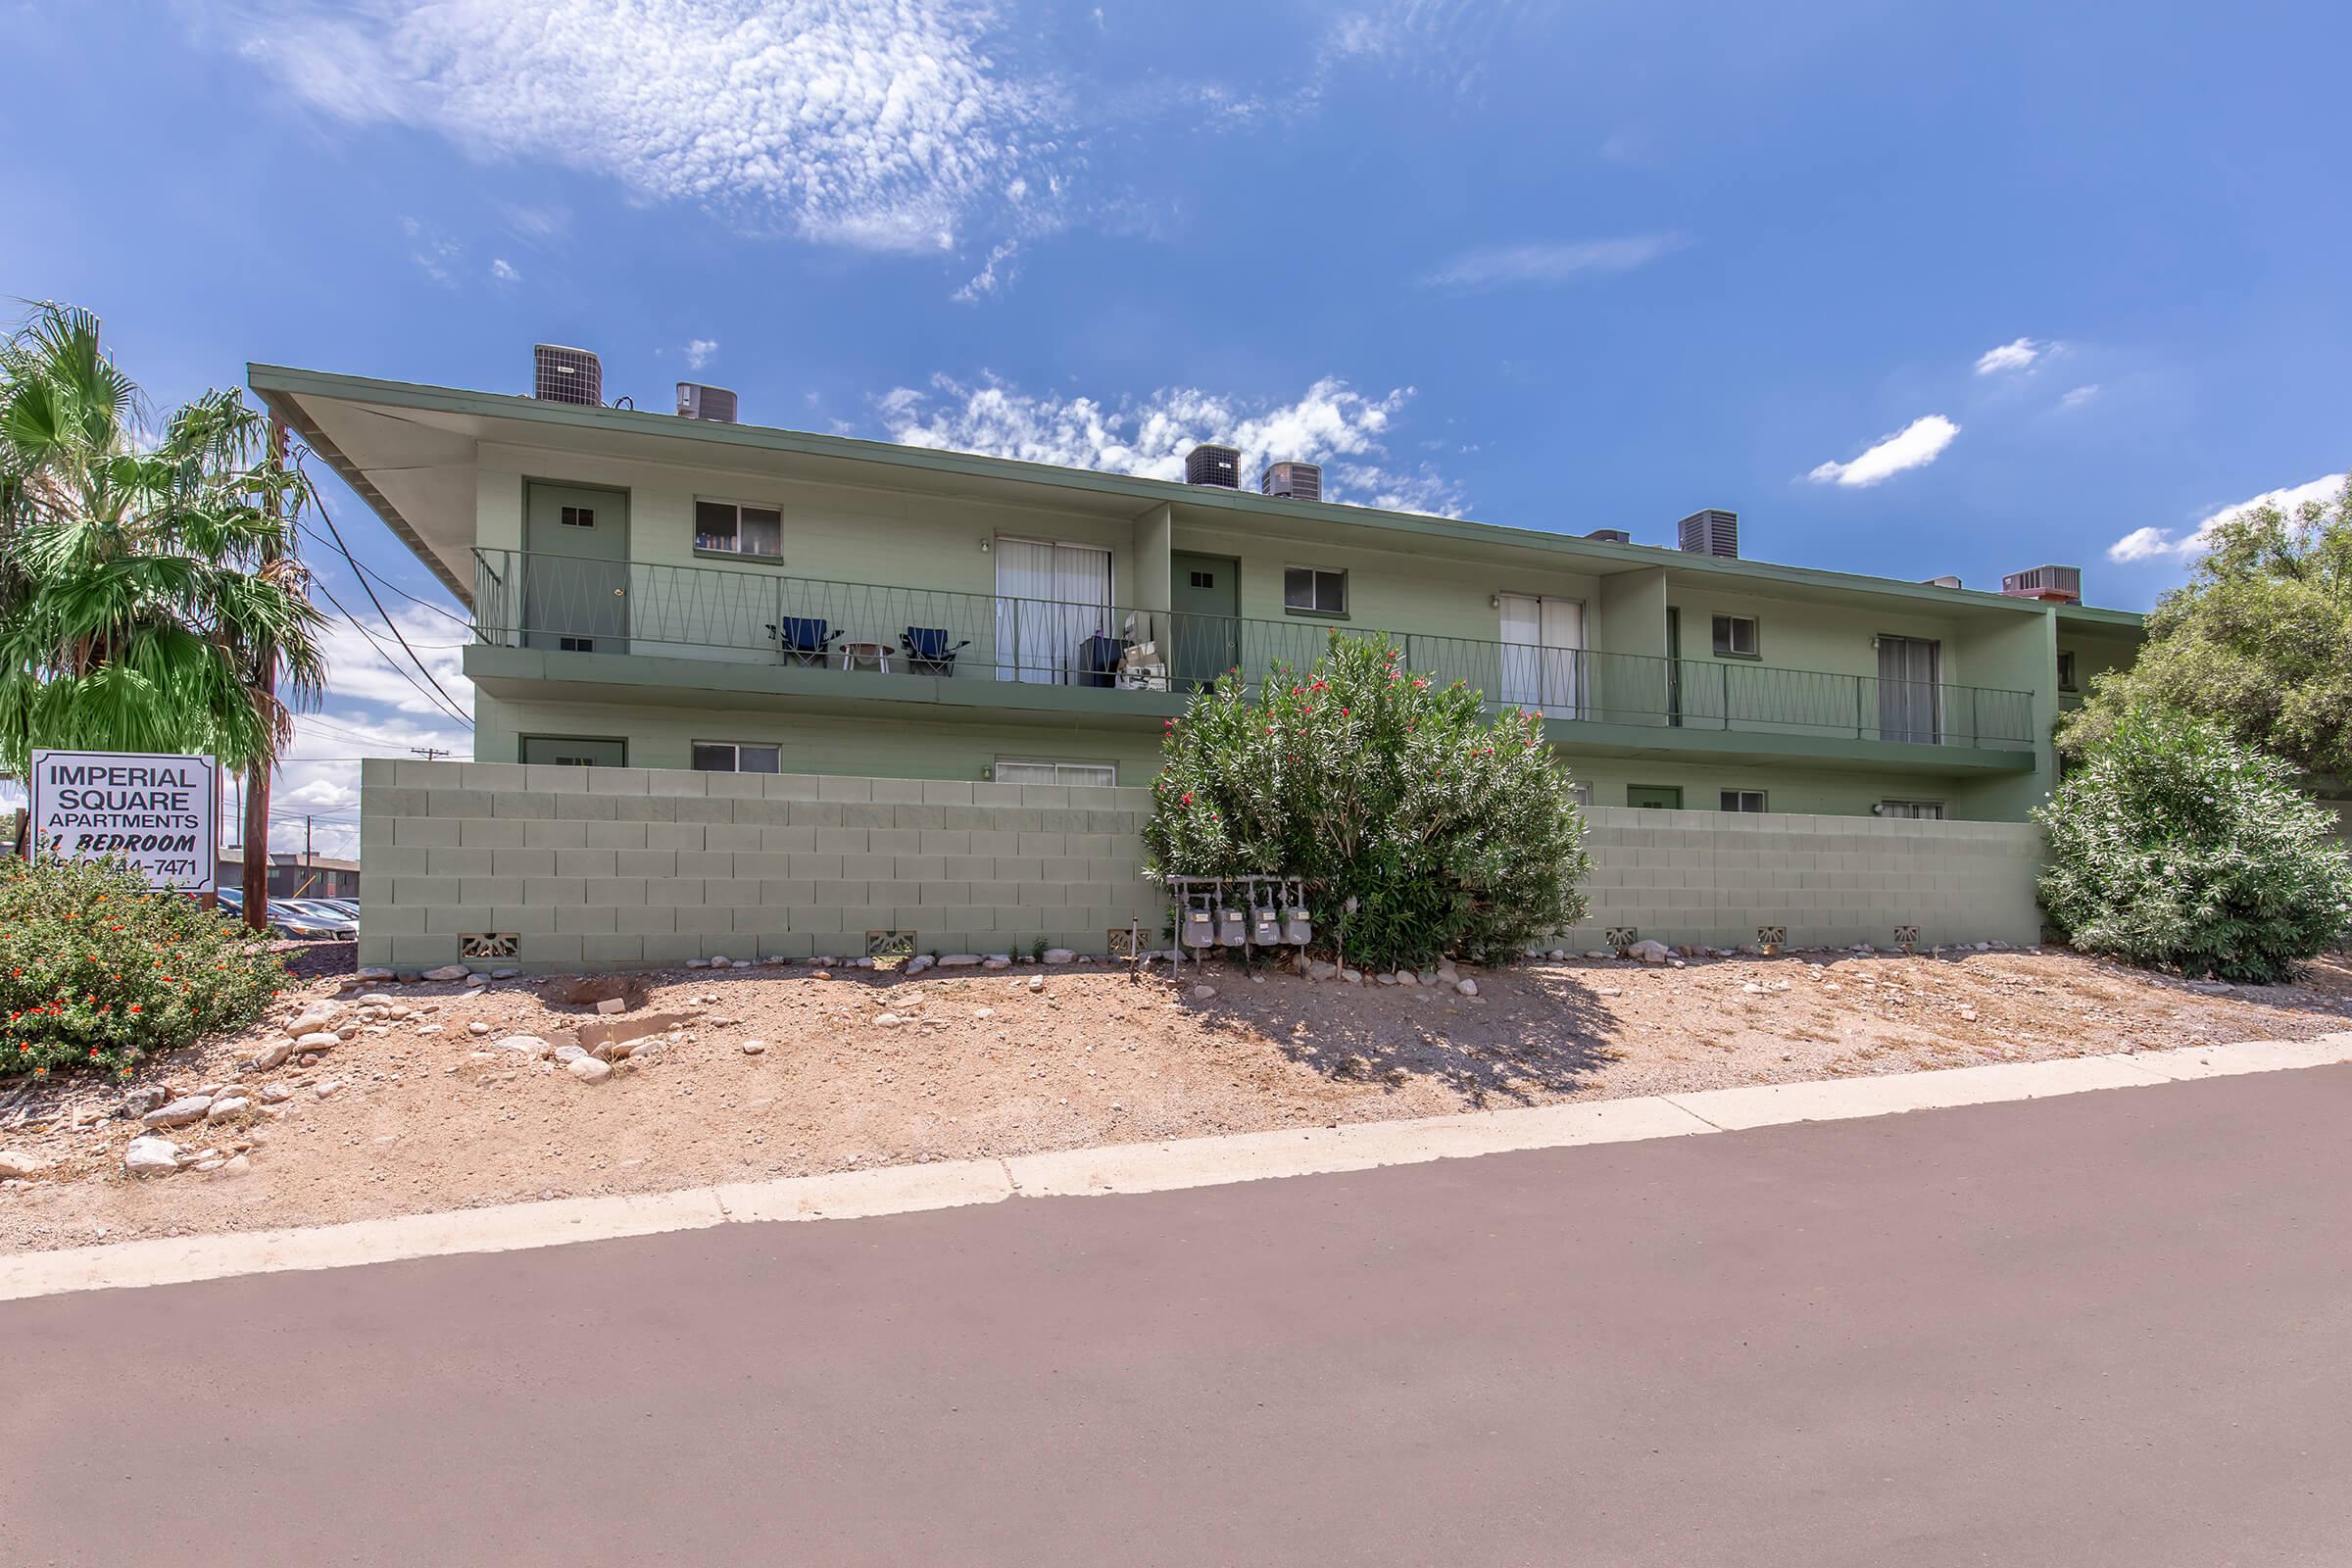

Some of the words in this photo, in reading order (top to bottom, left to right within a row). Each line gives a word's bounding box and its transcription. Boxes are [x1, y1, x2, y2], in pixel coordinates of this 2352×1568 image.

[51, 765, 197, 788] IMPERIAL
[58, 790, 190, 811] SQUARE
[49, 813, 199, 829] APARTMENTS
[51, 834, 64, 852] 1
[75, 834, 196, 853] BEDROOM
